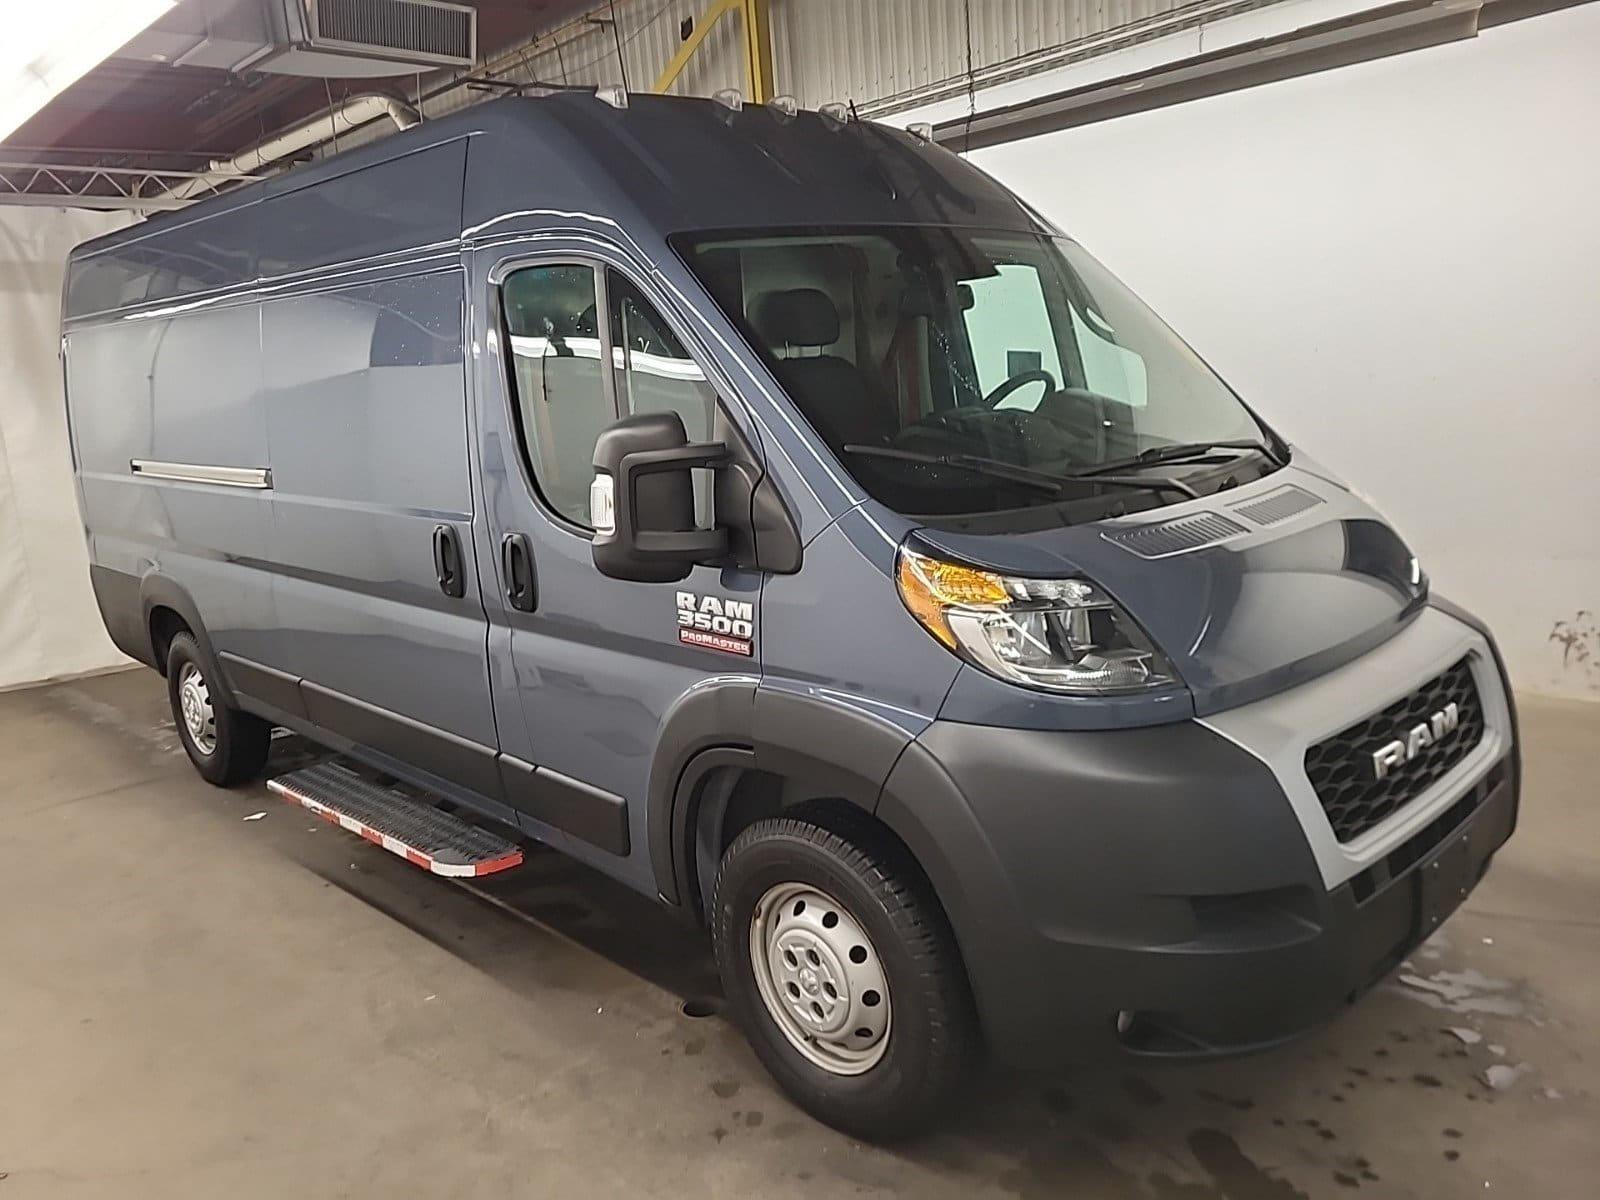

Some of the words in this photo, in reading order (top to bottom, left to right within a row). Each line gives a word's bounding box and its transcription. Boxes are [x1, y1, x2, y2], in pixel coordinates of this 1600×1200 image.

[676, 591, 753, 620] RAM
[677, 609, 752, 638] 3500
[1373, 702, 1458, 780] RAM
